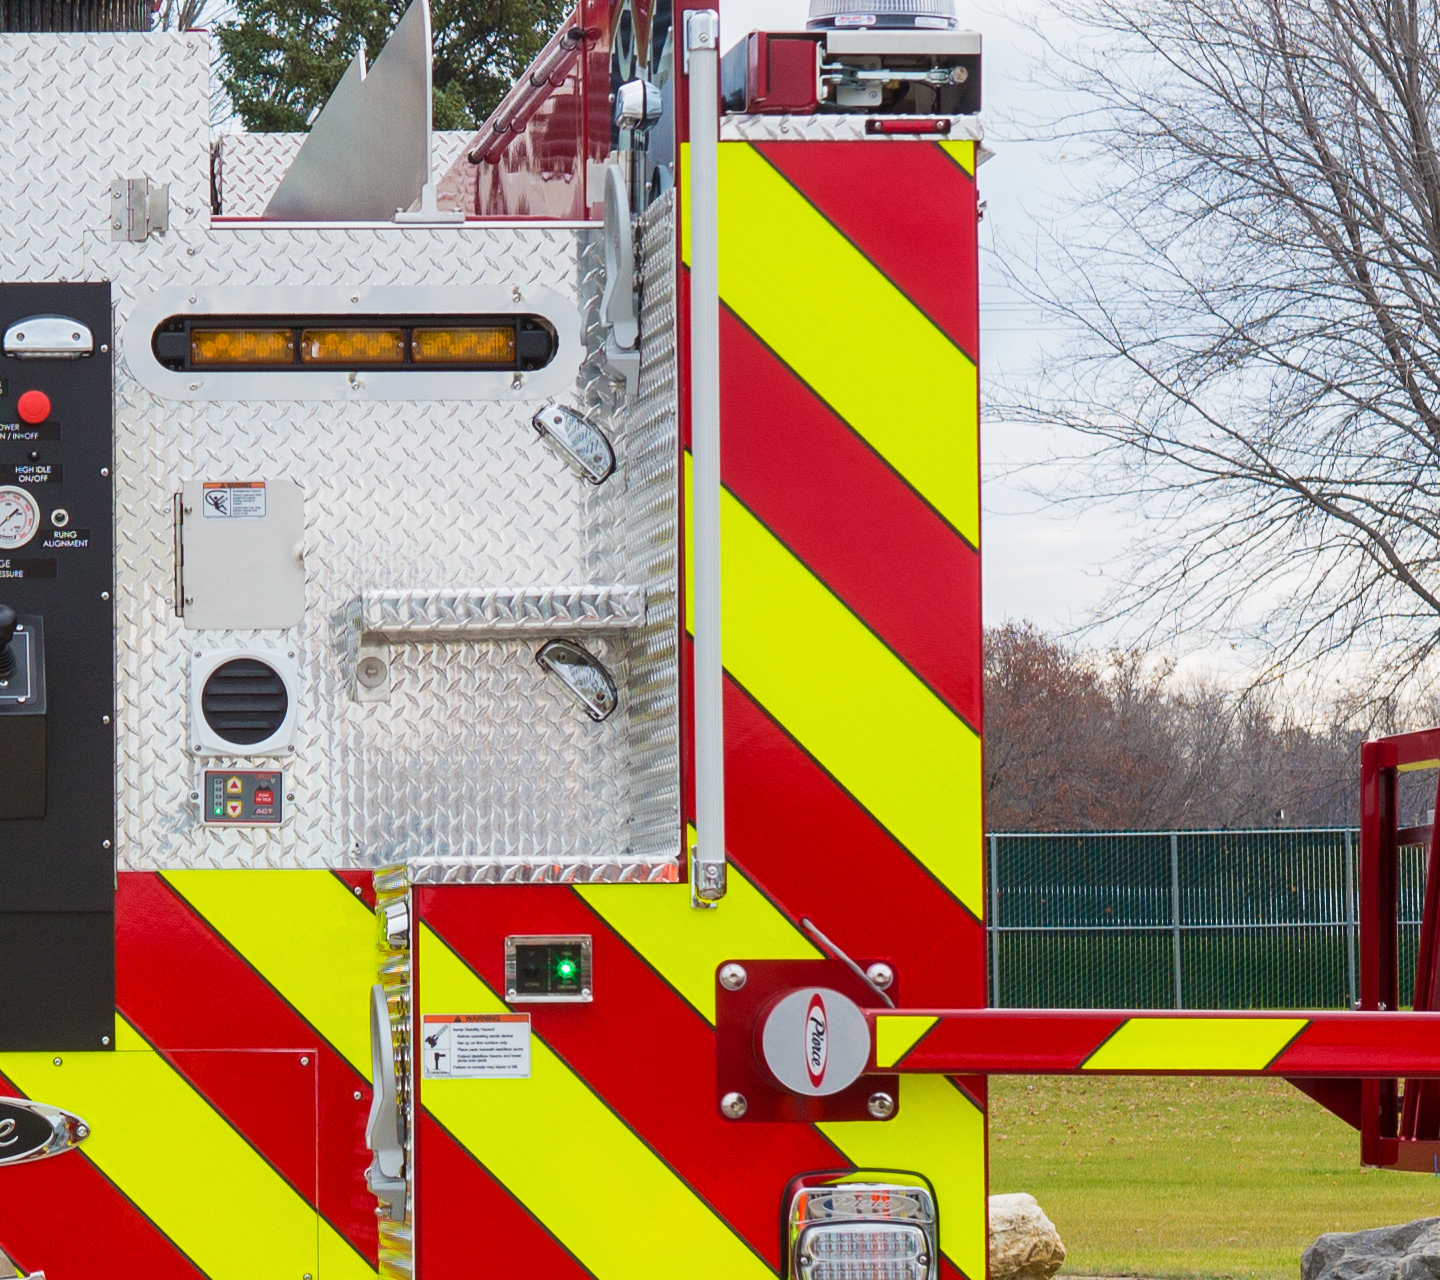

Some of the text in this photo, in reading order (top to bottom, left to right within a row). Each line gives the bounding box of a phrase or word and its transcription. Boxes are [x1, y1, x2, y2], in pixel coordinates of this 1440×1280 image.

[53, 531, 77, 539] RUNG
[43, 540, 88, 548] ALIGNMENT
[810, 1016, 825, 1067] Pierce
